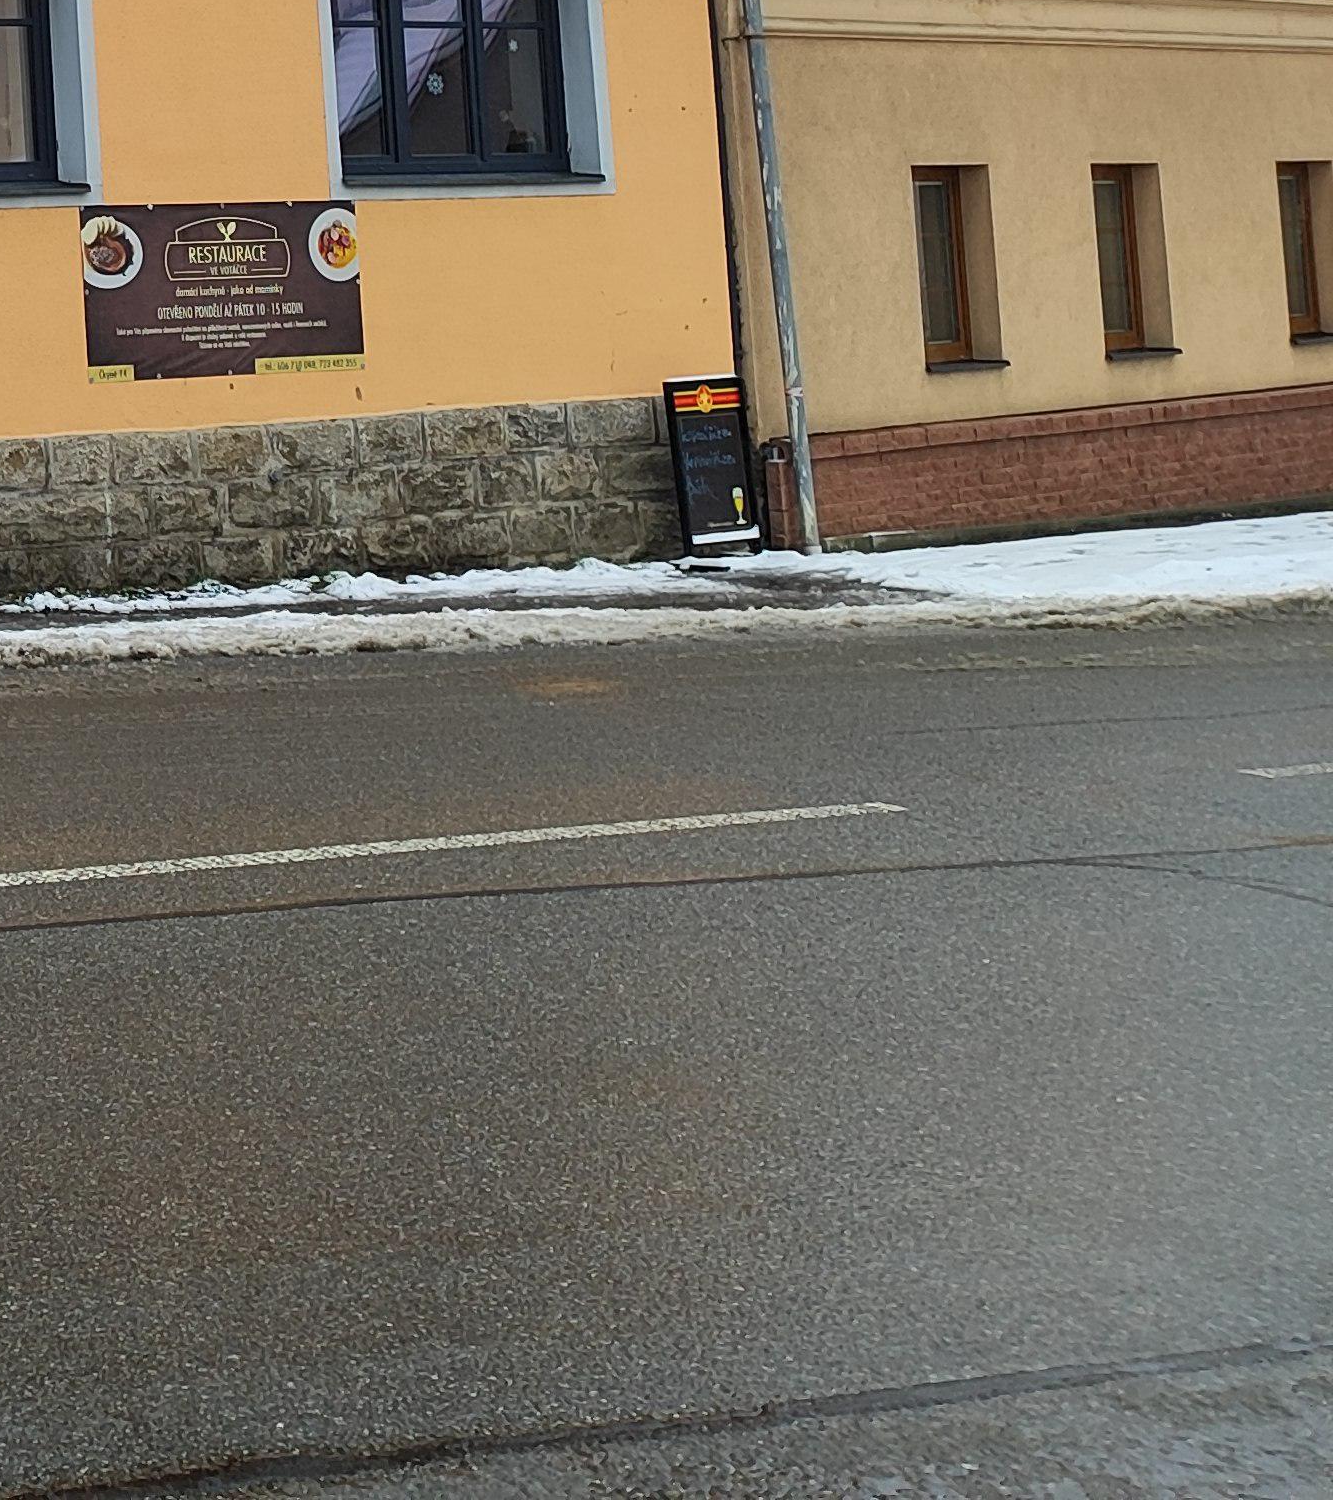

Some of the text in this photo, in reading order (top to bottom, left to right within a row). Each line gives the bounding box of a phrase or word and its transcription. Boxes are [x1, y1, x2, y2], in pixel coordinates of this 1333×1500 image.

[188, 244, 267, 264] RESTAURACE
[209, 266, 219, 276] VE
[157, 304, 193, 320] OTEVŘENO
[194, 303, 223, 319] PONDĚLÍ
[224, 302, 233, 317] AŽ
[256, 302, 266, 316] 10
[271, 302, 281, 315] 15
